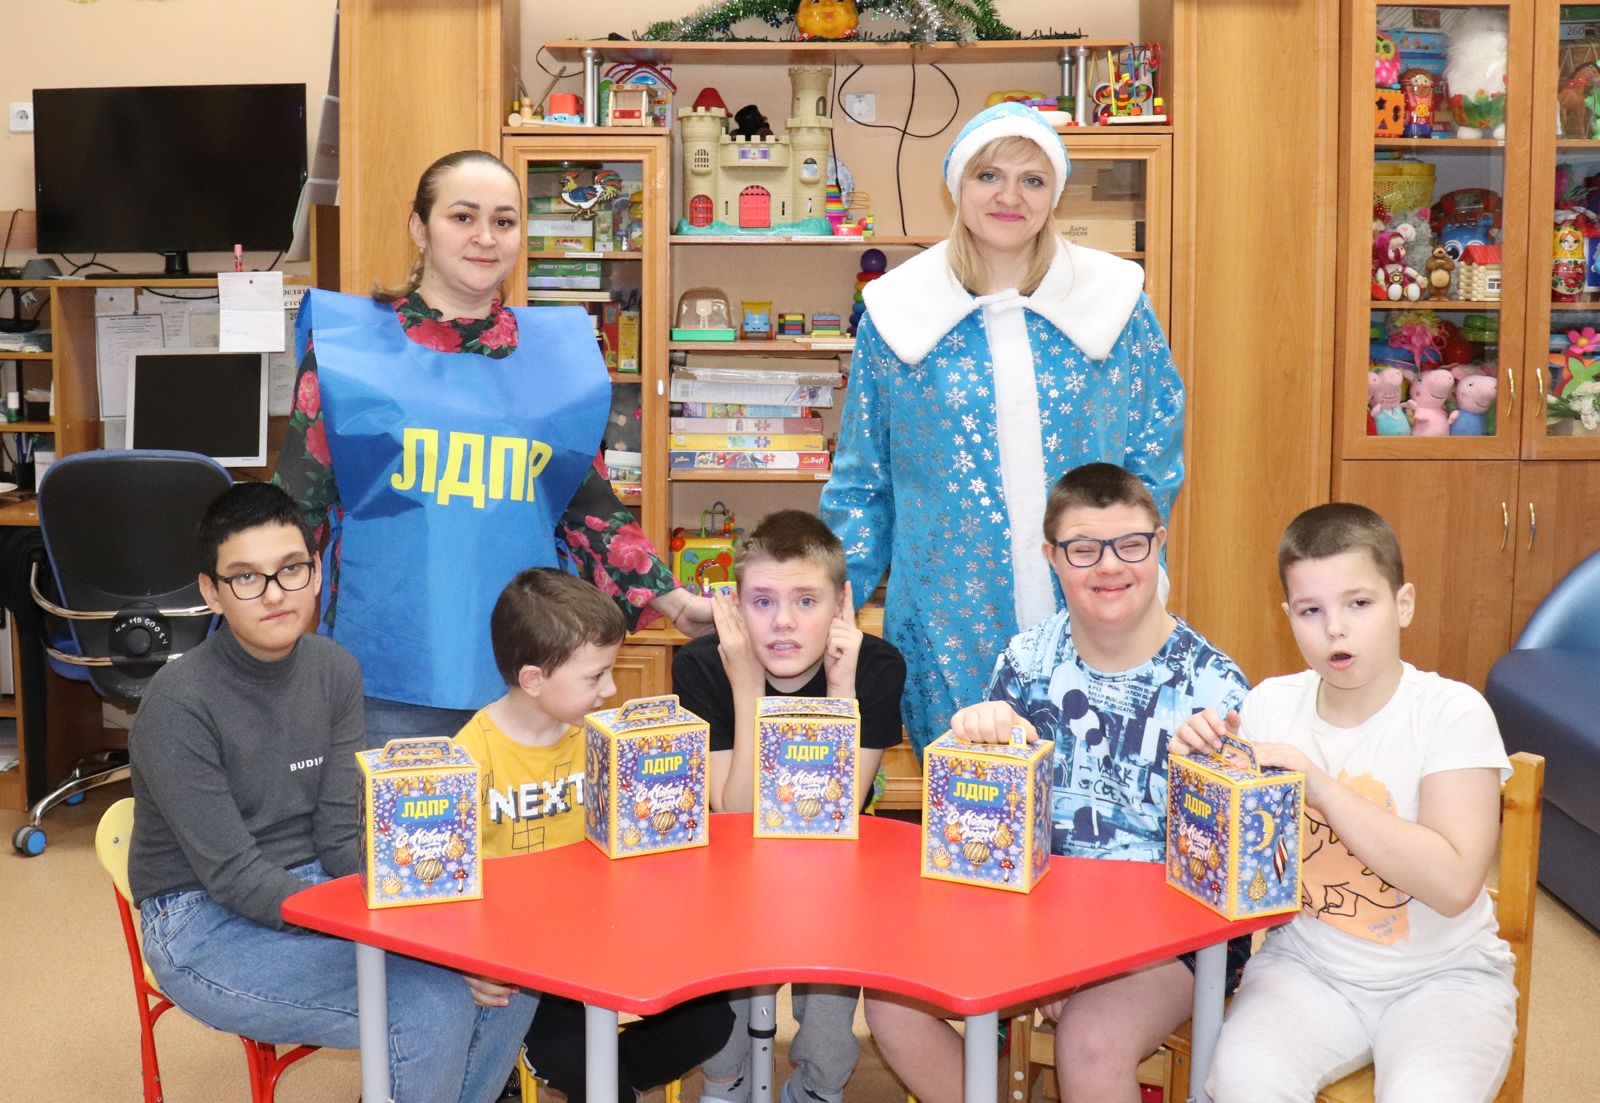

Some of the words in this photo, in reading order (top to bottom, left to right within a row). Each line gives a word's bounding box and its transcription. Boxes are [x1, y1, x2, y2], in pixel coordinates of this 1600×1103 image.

[390, 427, 553, 509] ЛДПР
[785, 745, 829, 762] ЛДПР
[641, 755, 683, 775] ЛДПР
[488, 772, 585, 824] NEXT
[953, 782, 999, 802] ЛДПР
[401, 798, 450, 819] ЛДПР
[1183, 793, 1212, 819] ЛДПР
